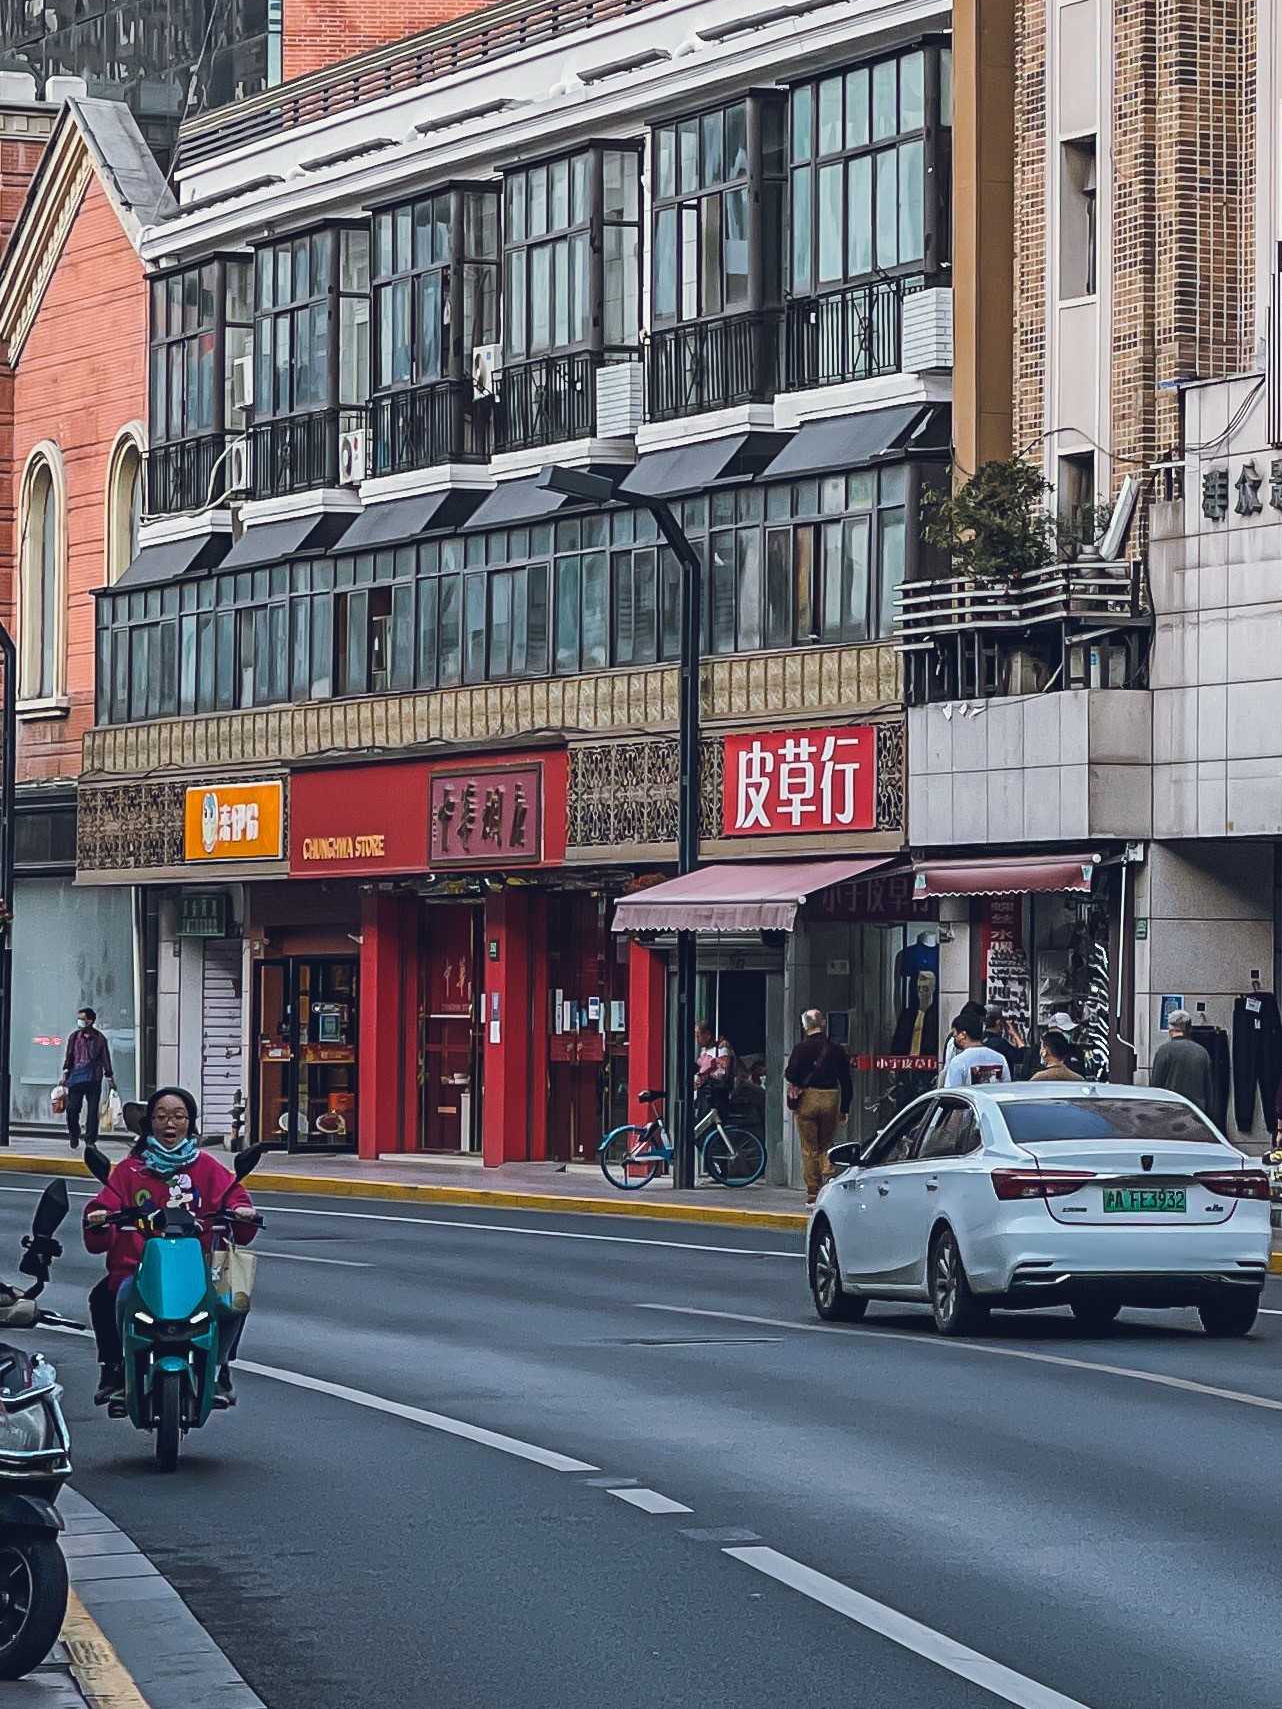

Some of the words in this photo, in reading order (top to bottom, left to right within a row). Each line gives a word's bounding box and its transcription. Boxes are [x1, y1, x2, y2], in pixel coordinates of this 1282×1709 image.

[735, 736, 860, 829] 皮草行
[355, 834, 385, 857] STORE
